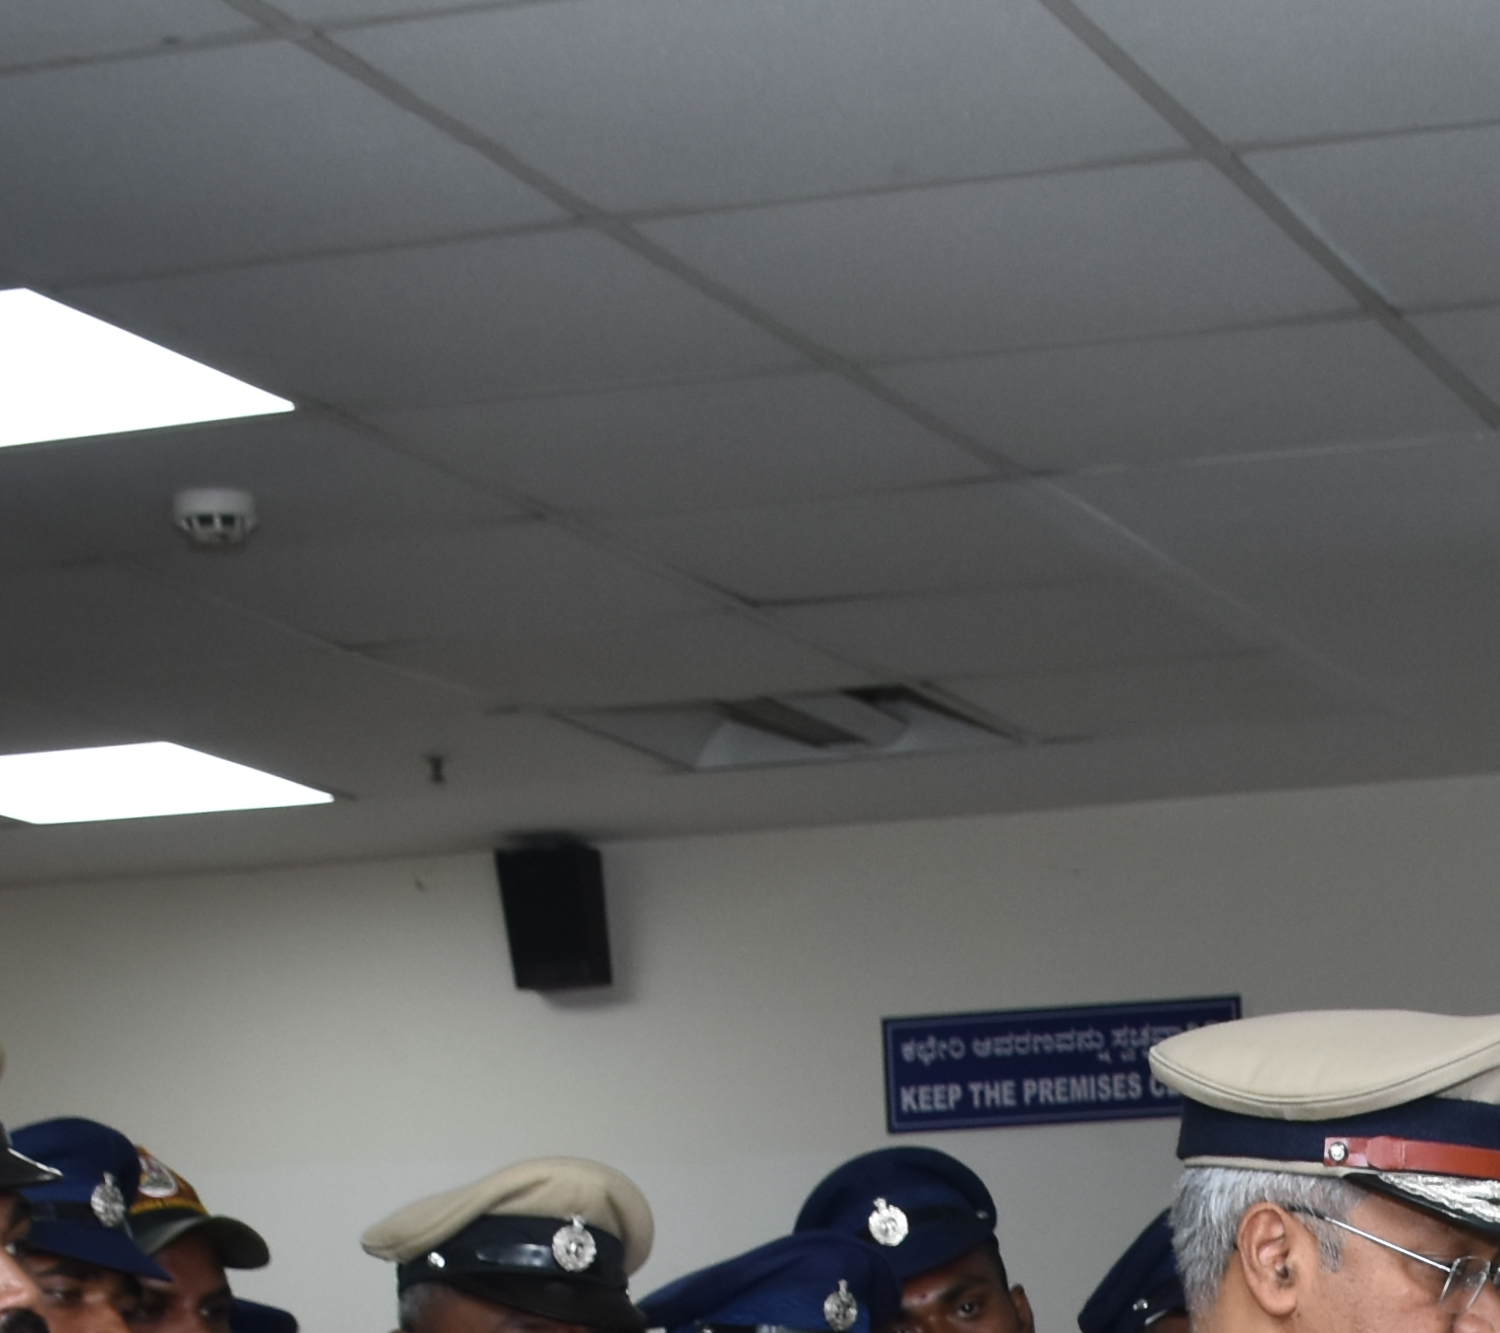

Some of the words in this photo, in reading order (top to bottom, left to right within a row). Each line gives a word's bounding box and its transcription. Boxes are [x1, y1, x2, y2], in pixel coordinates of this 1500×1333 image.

[900, 1084, 962, 1113] KEEP
[969, 1080, 1016, 1109] THE
[1023, 1072, 1142, 1106] PREMISES
